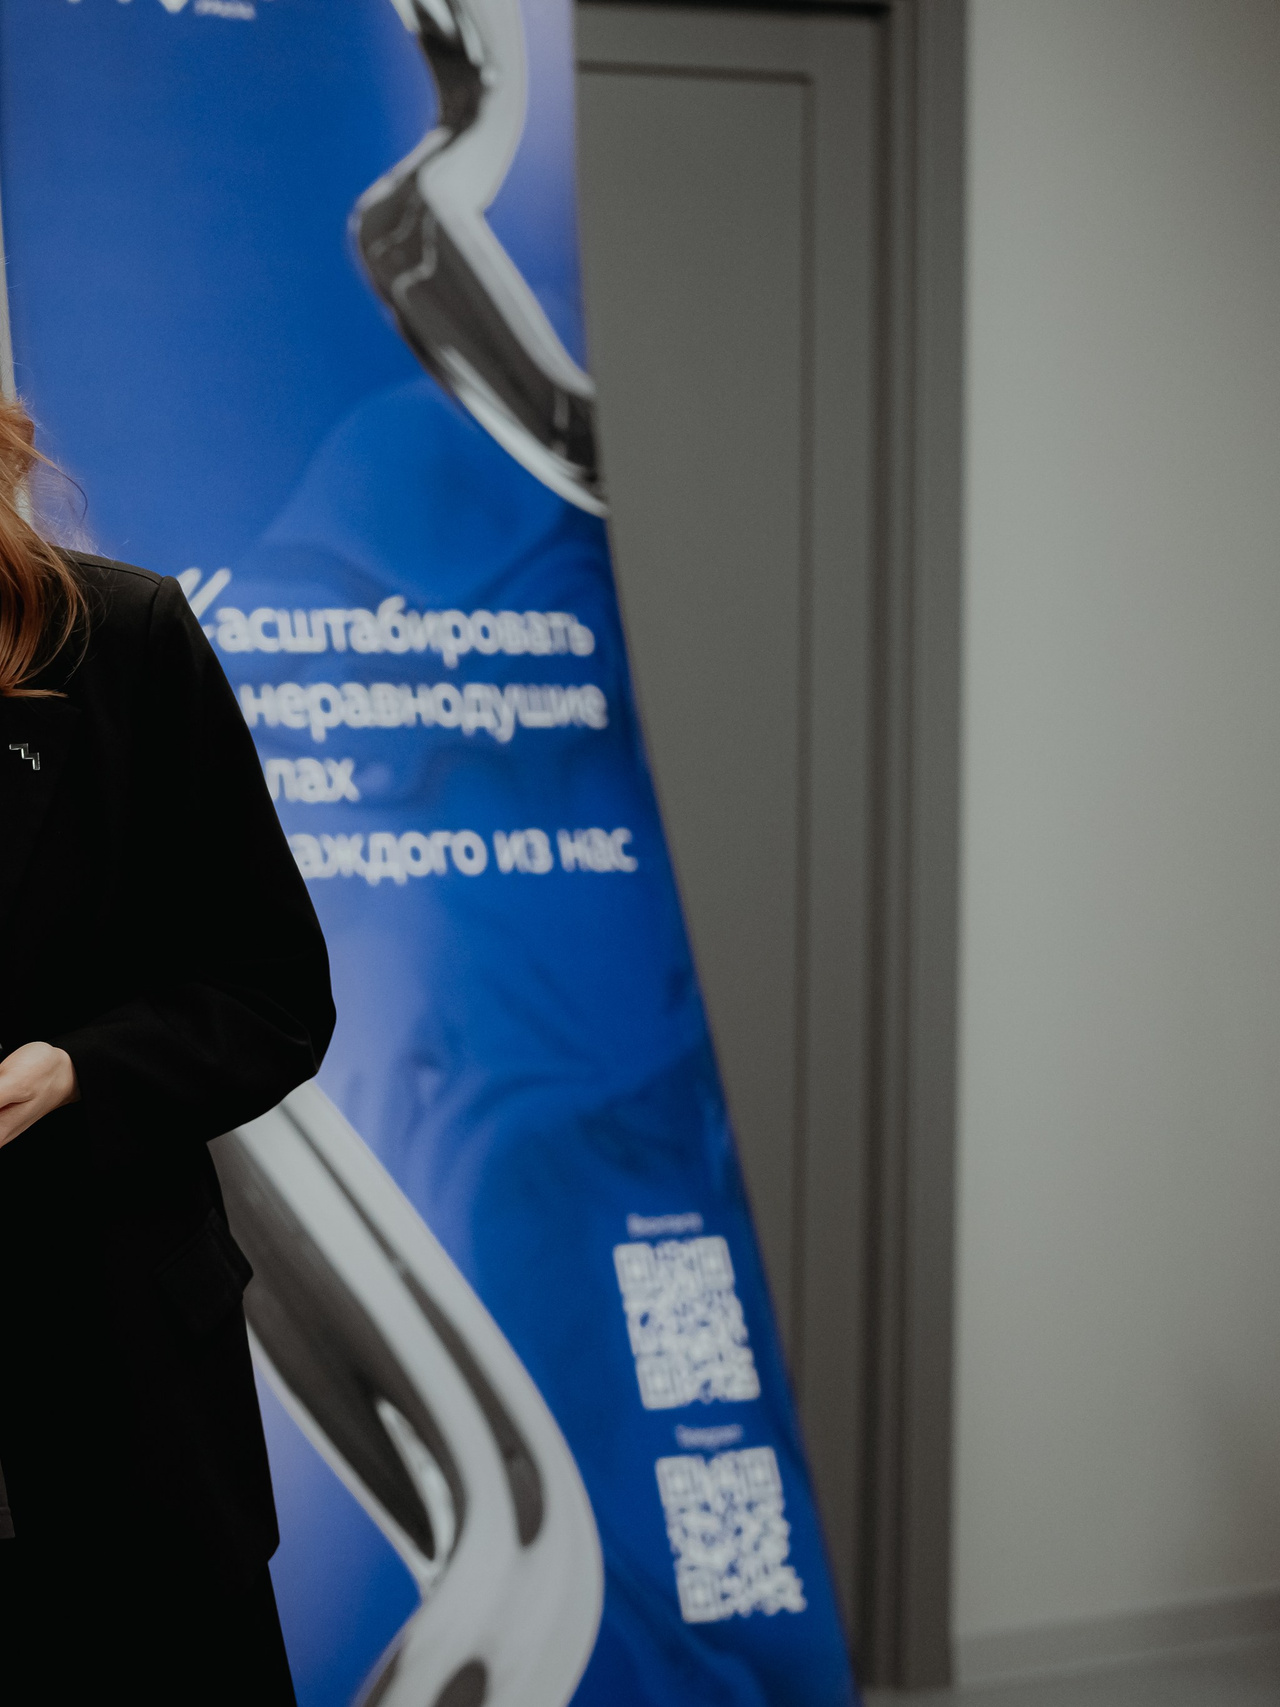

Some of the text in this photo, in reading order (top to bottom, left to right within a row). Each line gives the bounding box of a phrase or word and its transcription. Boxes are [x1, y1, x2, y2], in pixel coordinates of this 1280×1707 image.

[240, 682, 608, 743] неравнодушие
[287, 828, 637, 886] аждого из нас
